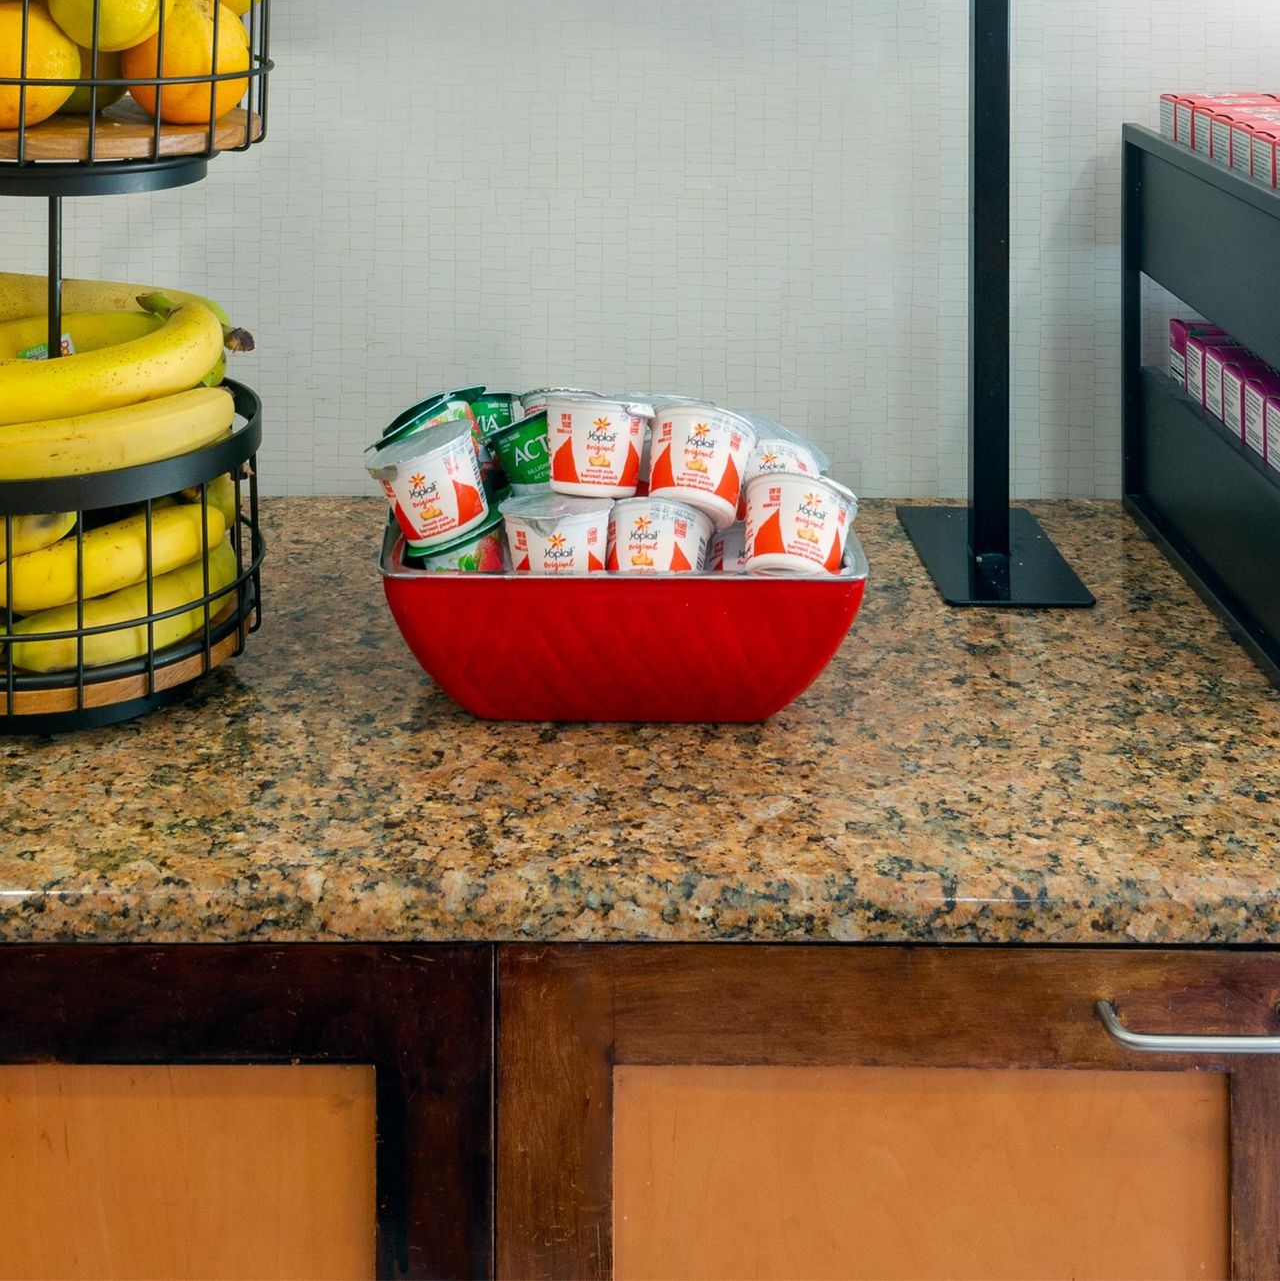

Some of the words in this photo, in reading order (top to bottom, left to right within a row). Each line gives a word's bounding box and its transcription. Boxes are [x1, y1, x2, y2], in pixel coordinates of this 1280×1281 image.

[587, 430, 616, 444] Yoplait
[686, 435, 715, 449] Yoplait
[629, 530, 658, 543] Yoplait
[544, 547, 573, 561] Yoplait
